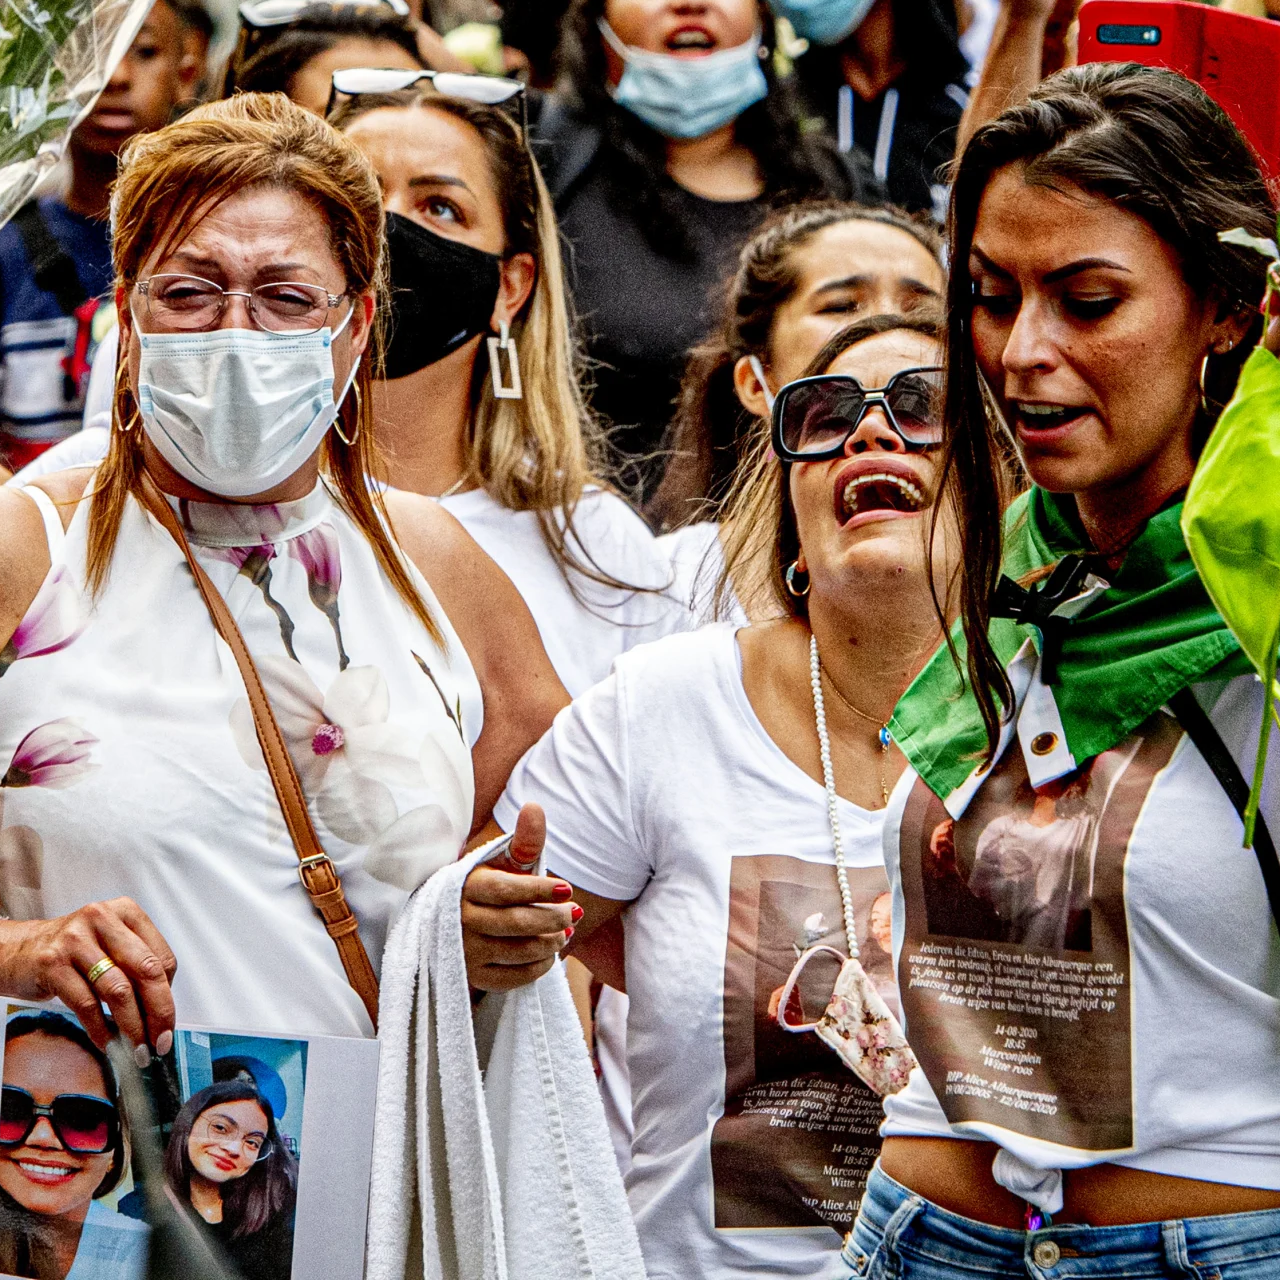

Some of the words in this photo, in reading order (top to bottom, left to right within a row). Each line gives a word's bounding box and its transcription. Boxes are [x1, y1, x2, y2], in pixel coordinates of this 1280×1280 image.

[954, 946, 966, 957] die
[992, 950, 1012, 963] Erica
[1012, 954, 1022, 963] en
[1023, 953, 1041, 966] Alice
[1094, 963, 1114, 972] een
[908, 955, 937, 966] warm
[937, 956, 955, 968] hart
[1087, 973, 1125, 987] geweld
[920, 967, 944, 979] join
[944, 971, 956, 981] us
[957, 973, 967, 982] en
[968, 972, 986, 983] toon
[1031, 978, 1049, 990] door
[1049, 983, 1061, 992] een
[1082, 988, 1104, 997] roos
[1107, 987, 1118, 997] te
[938, 992, 967, 1006] brute
[991, 1000, 1007, 1011] van
[951, 983, 965, 996] op
[965, 983, 977, 995] de
[976, 985, 994, 999] plek
[1101, 1000, 1116, 1012] op
[995, 1024, 1038, 1039] 14-08-2020
[1004, 1038, 1027, 1050] 18:45
[979, 1045, 1042, 1066] Marconiplein
[984, 1056, 1011, 1072] Witte
[1011, 1065, 1034, 1076] roos
[790, 1077, 806, 1088] die
[842, 1083, 870, 1097] Erica
[946, 1071, 963, 1082] RIP
[962, 1073, 988, 1087] Alice
[769, 1087, 789, 1098] hart
[840, 1094, 854, 1107] of
[853, 1097, 881, 1109] simpe
[780, 1108, 794, 1119] op
[794, 1107, 809, 1119] de
[809, 1111, 832, 1122] plek
[833, 1115, 861, 1124] waar
[861, 1115, 881, 1126] Alic
[786, 1099, 799, 1107] en
[800, 1099, 824, 1110] toon
[823, 1104, 836, 1115] je
[836, 1106, 884, 1117] medeleve
[769, 1115, 797, 1128] brute
[798, 1120, 826, 1132] wijze
[827, 1123, 846, 1132] van
[848, 1124, 875, 1136] haar
[831, 1143, 881, 1158] 14-08-202
[843, 1155, 869, 1166] 18:45
[822, 1165, 870, 1181] Marconip
[831, 1176, 857, 1189] Witte
[819, 1199, 845, 1211] Alice
[845, 1200, 863, 1211] Alb
